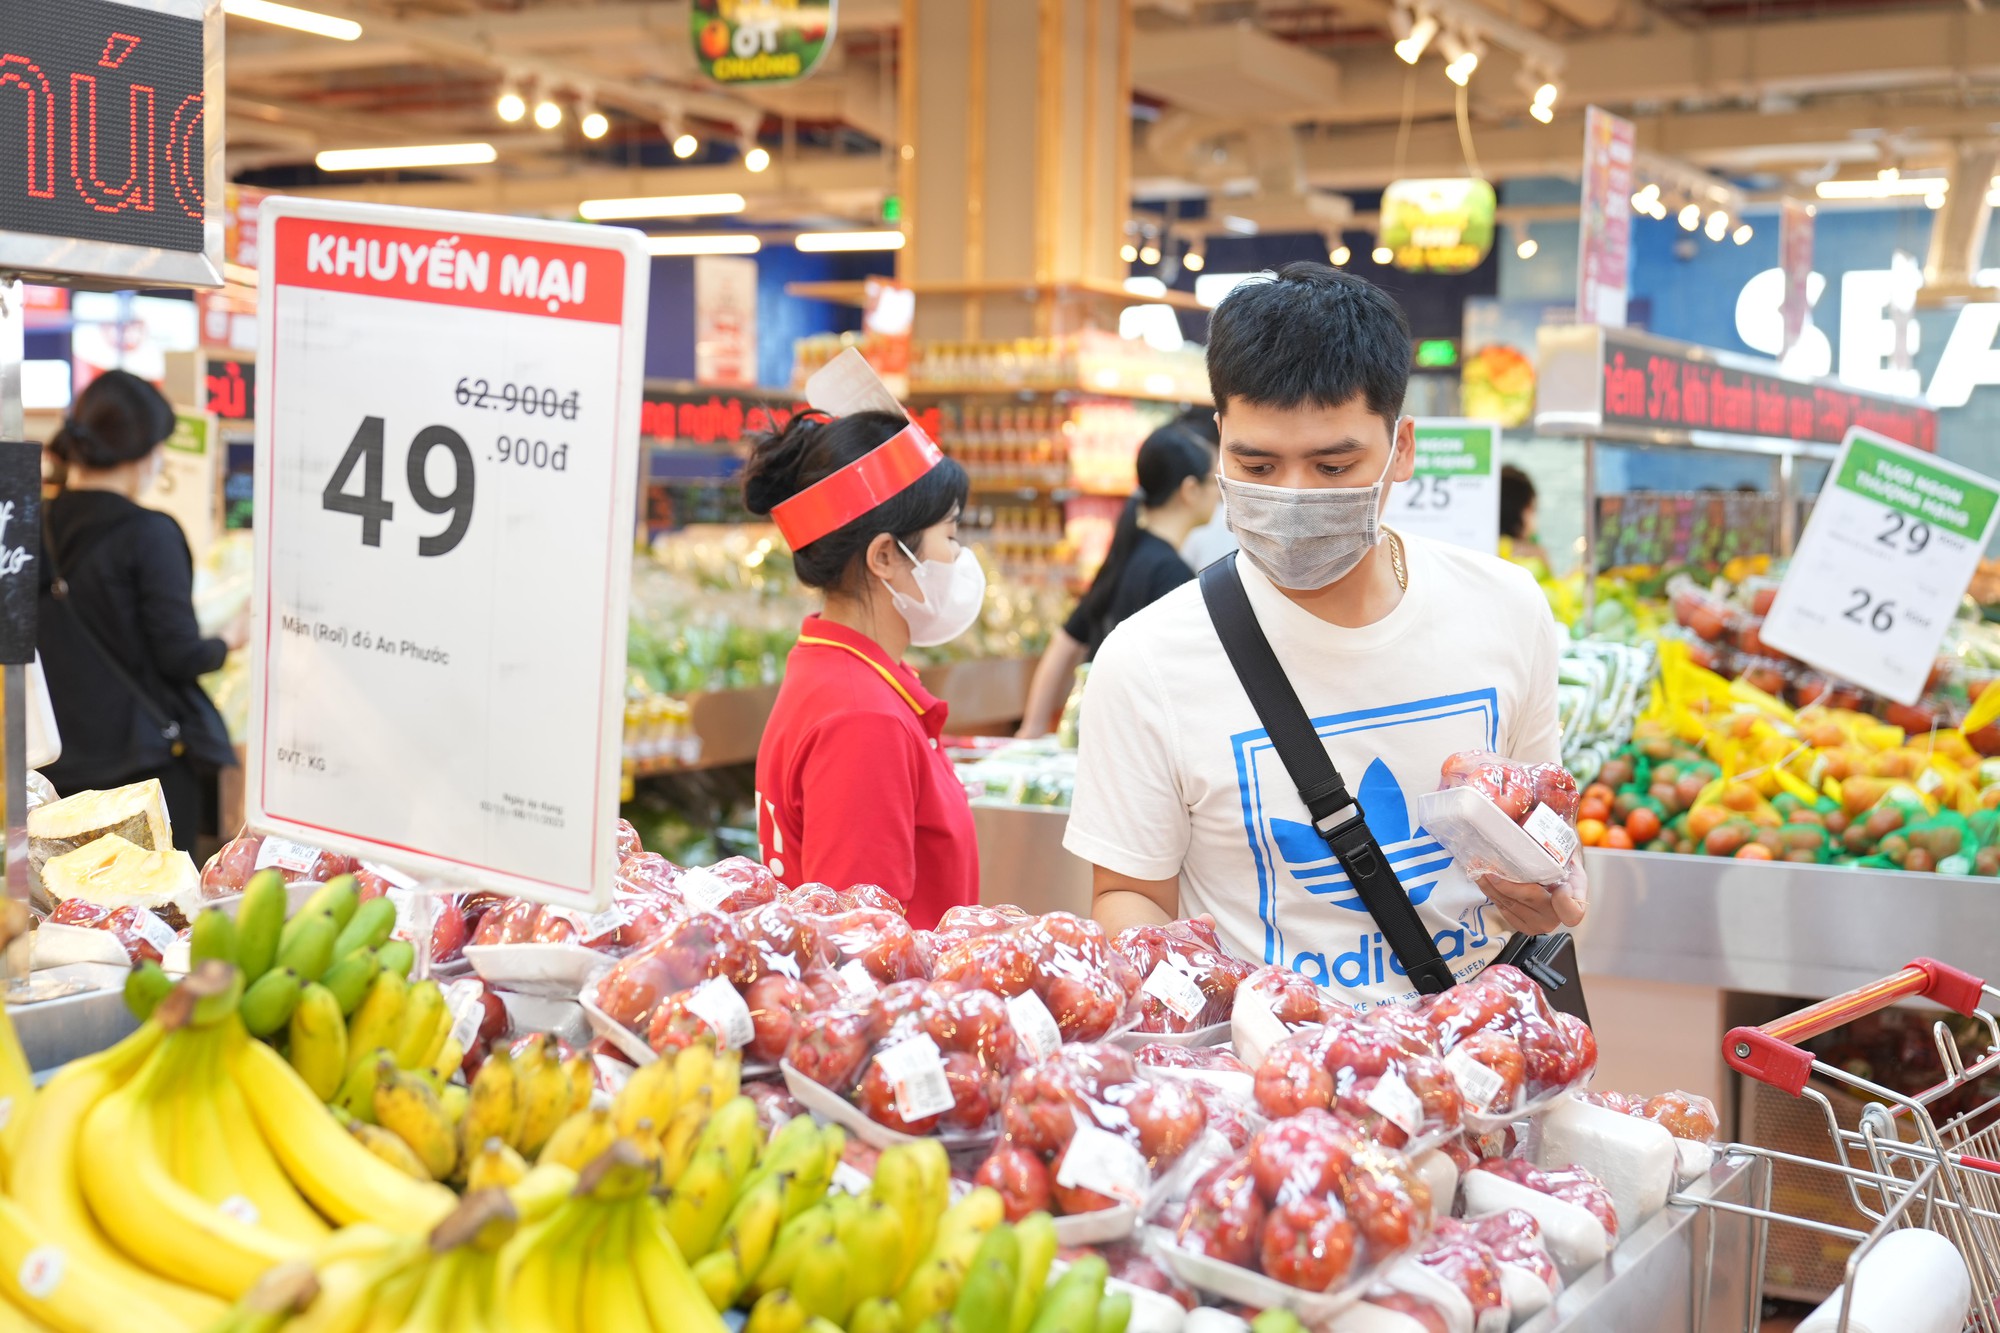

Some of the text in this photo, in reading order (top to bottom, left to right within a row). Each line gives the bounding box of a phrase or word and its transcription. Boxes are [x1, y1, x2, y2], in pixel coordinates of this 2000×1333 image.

[307, 233, 587, 313] KHUYẾN MẠI
[456, 377, 579, 420] 62.900đ
[323, 415, 569, 557] 49 .900đ
[1406, 477, 1451, 510] 25
[1913, 475, 1965, 507] NGON
[1877, 510, 1931, 555] 29
[1842, 587, 1895, 633] 26
[376, 636, 397, 655] An
[400, 640, 451, 666] Phước
[308, 756, 327, 771] KG
